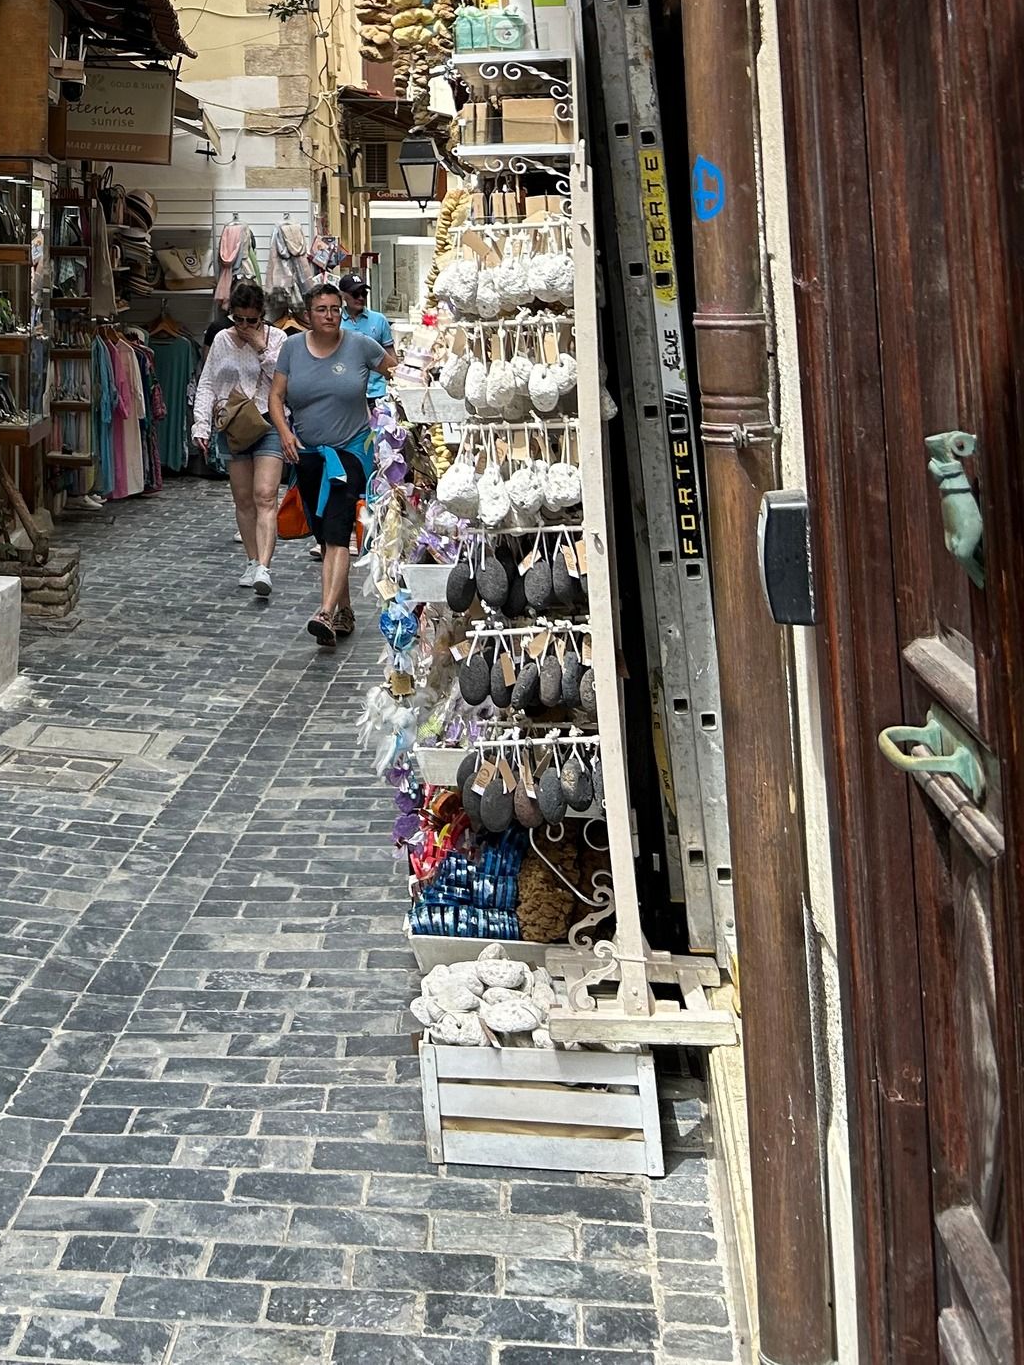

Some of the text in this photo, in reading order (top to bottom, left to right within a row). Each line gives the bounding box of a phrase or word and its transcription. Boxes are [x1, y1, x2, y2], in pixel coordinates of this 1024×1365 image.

[110, 80, 131, 89] GOLD
[141, 81, 166, 90] SILVER
[67, 101, 135, 116] aterina
[91, 117, 135, 128] sunrise
[95, 142, 144, 153] JEWELLERY
[644, 155, 669, 265] FORTE
[674, 440, 699, 555] FORTE
